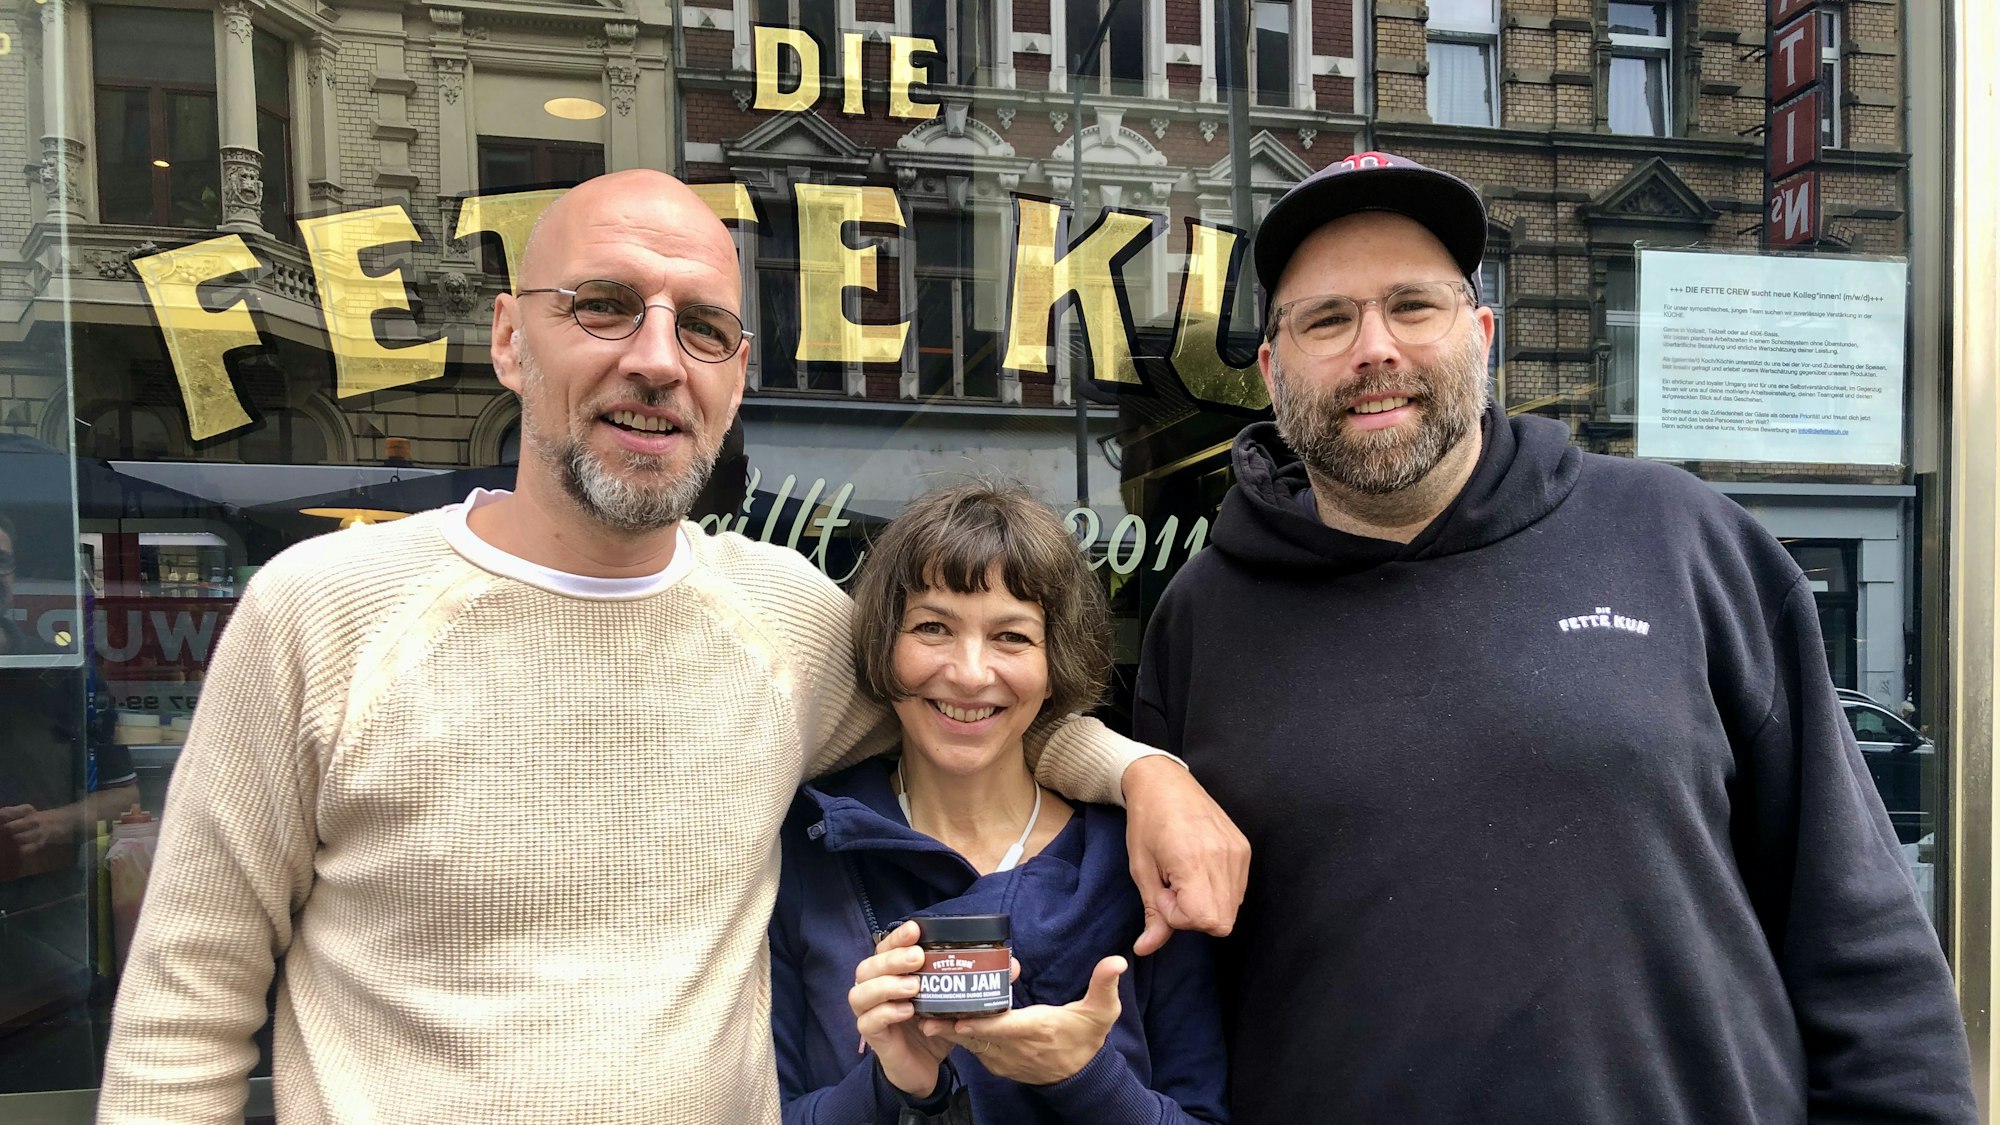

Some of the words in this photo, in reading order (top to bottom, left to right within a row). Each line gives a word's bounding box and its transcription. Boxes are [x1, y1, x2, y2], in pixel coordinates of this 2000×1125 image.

[753, 25, 942, 120] DIE
[1700, 287, 1725, 295] FETTE
[1726, 288, 1750, 296] CREW
[131, 183, 911, 441] FETE
[1002, 198, 1273, 410] KU
[1064, 507, 1209, 575] 2011
[1595, 606, 1612, 614] DIE
[1558, 614, 1611, 632] FETTE
[1613, 615, 1650, 635] KUH
[920, 974, 966, 992] ACON
[970, 973, 1001, 991] JAM
